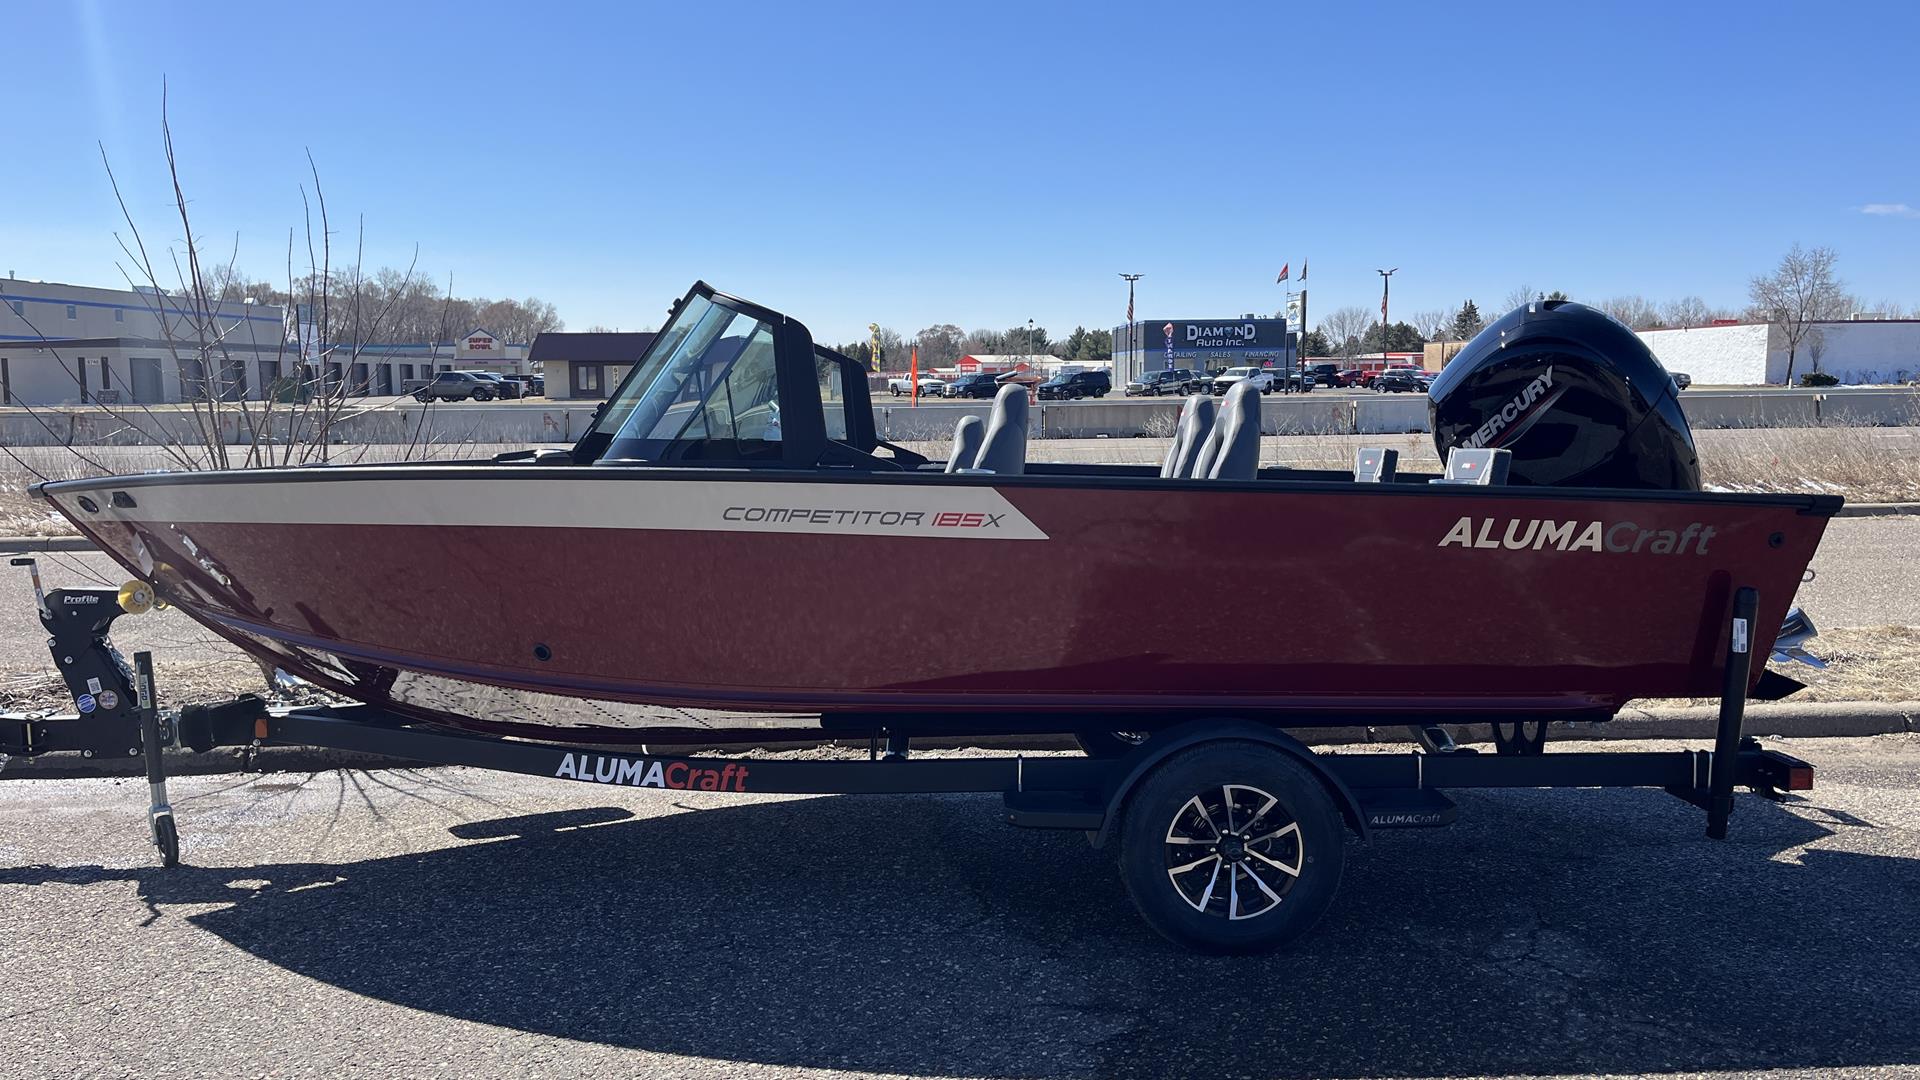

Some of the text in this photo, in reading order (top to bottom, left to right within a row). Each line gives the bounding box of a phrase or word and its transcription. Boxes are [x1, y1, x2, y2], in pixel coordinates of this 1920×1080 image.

[1196, 338, 1245, 347] Auto Inc.
[1461, 365, 1553, 448] MERCURY
[722, 506, 1006, 528] COMPETITOR 185X
[1437, 516, 1718, 555] ALUMACraft
[63, 595, 100, 605] Profile
[555, 752, 750, 792] ALUMACraft
[1371, 814, 1441, 824] ALUMACraft
